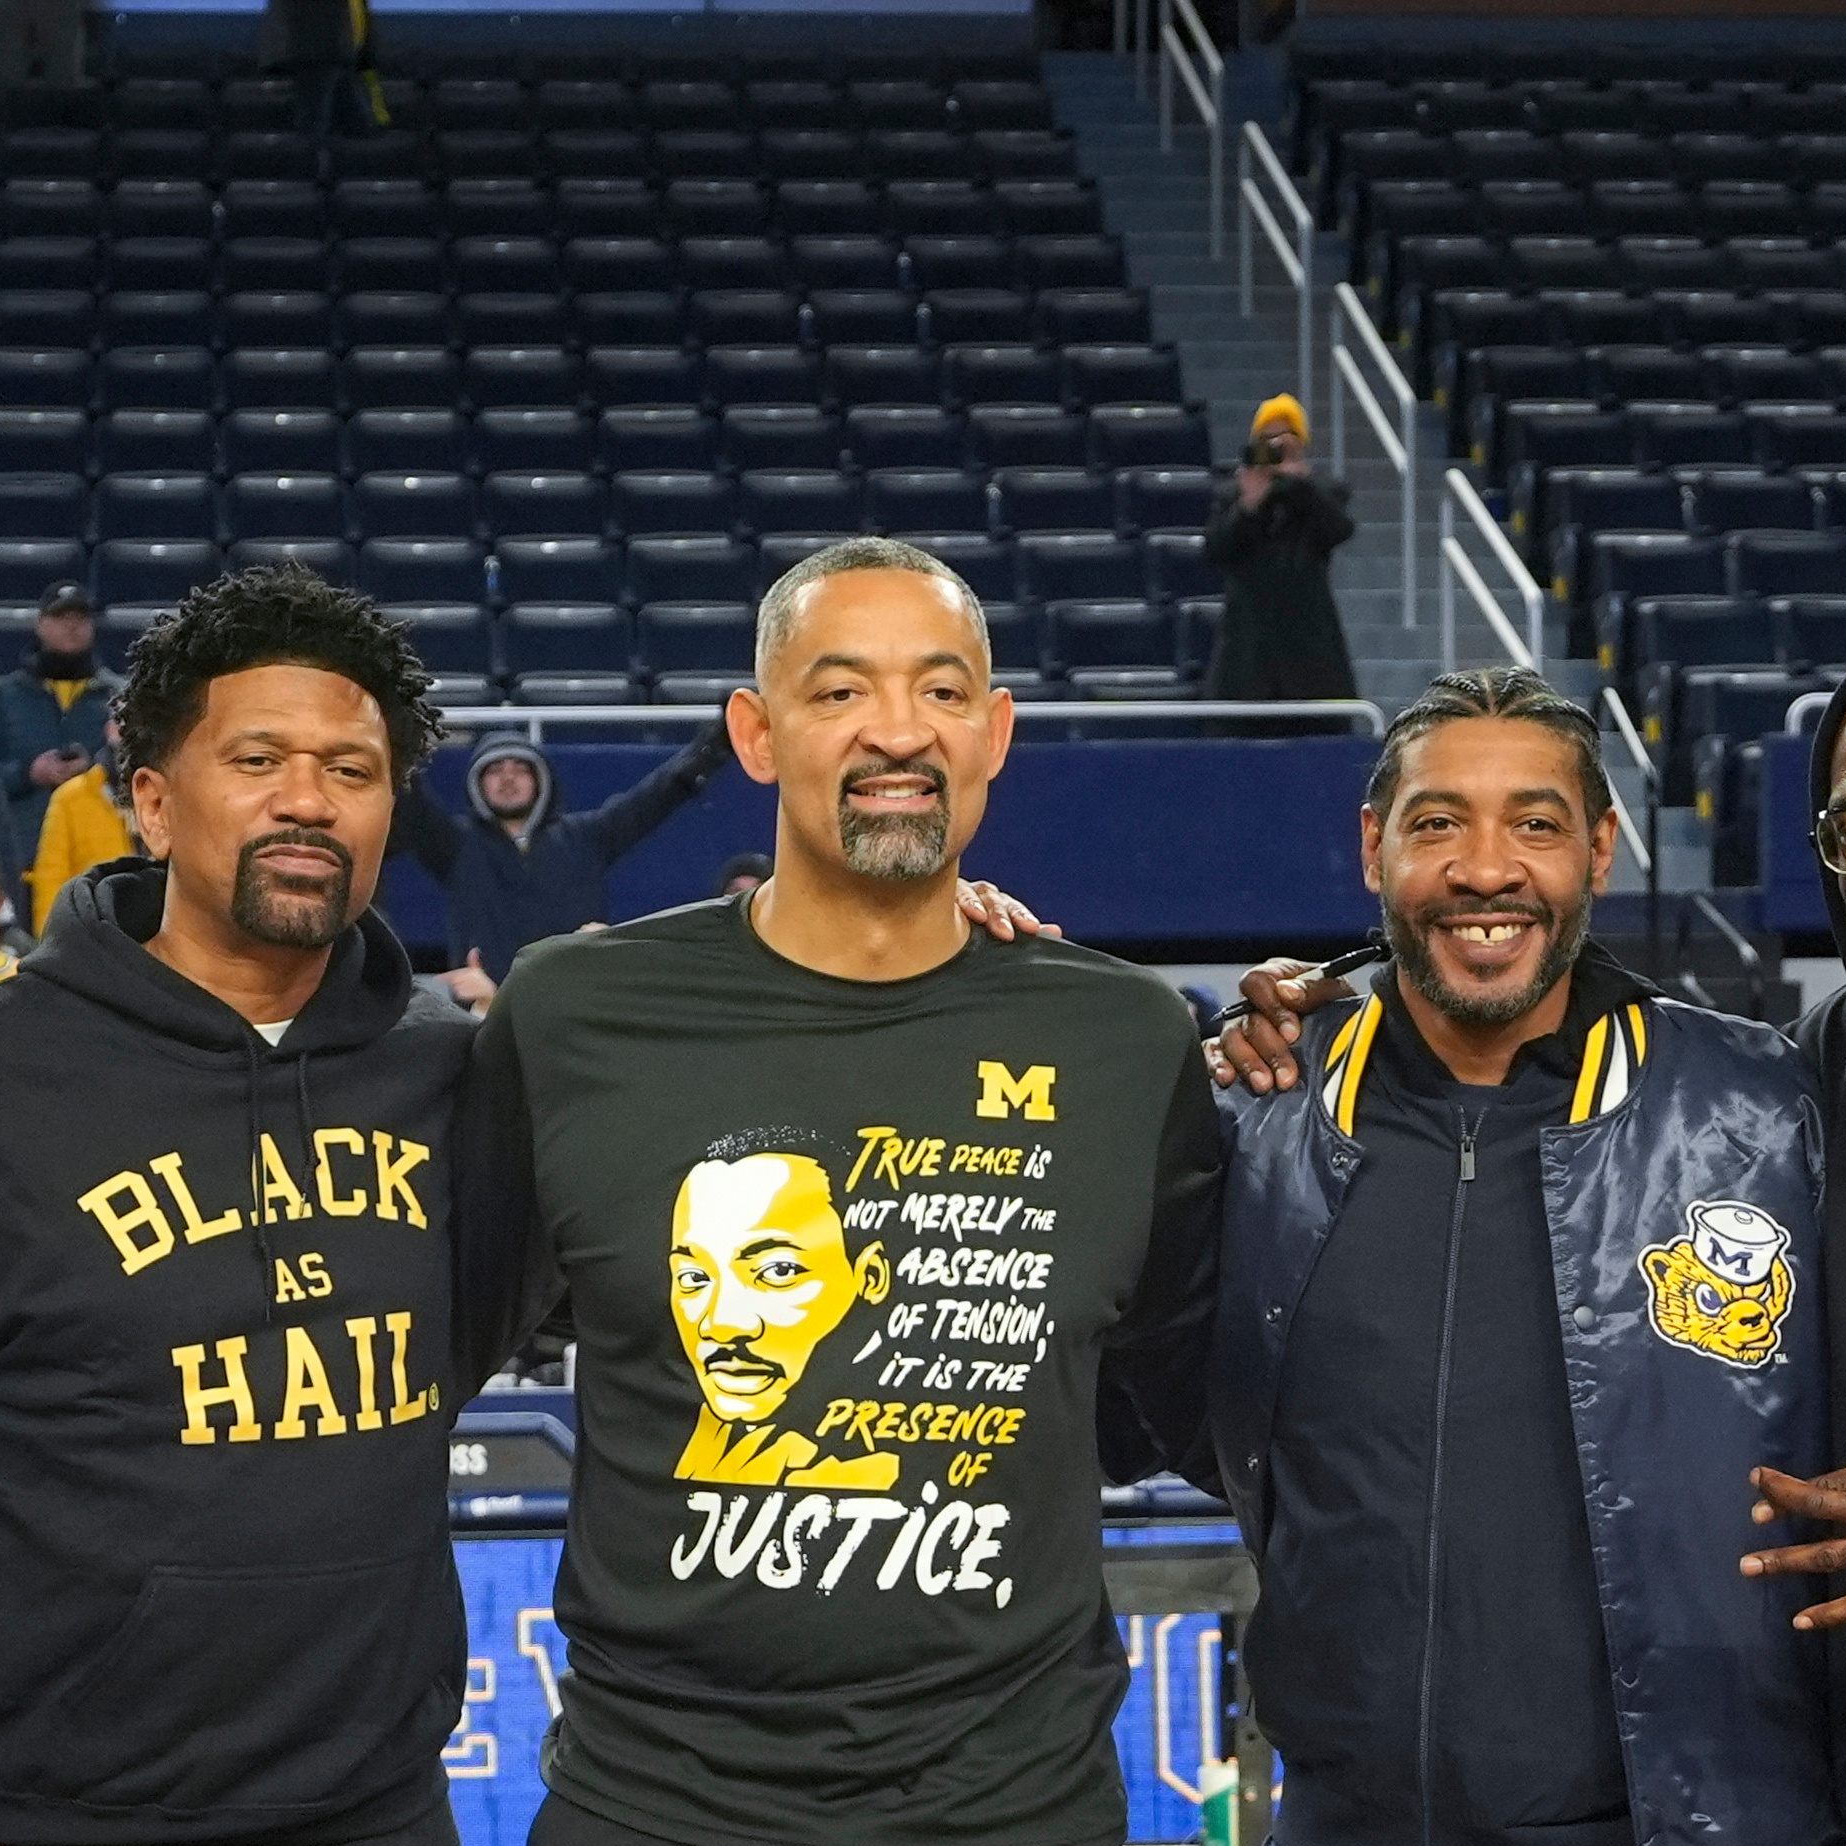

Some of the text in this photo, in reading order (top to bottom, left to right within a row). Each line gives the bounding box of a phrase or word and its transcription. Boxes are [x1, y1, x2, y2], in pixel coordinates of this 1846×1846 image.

[976, 1060, 1056, 1121] M
[844, 1126, 946, 1193] TRUE
[948, 1144, 1023, 1176] PEACE
[77, 1127, 430, 1276] BLACK
[843, 1192, 1056, 1242] NOT MERELY THE
[275, 1252, 333, 1303] AS
[896, 1246, 1054, 1290] ABSENCE
[1707, 1236, 1753, 1276] M
[887, 1301, 929, 1342] OF
[966, 1360, 1031, 1393] THE
[815, 1398, 1026, 1452] PRESENCE
[947, 1450, 993, 1487] OF
